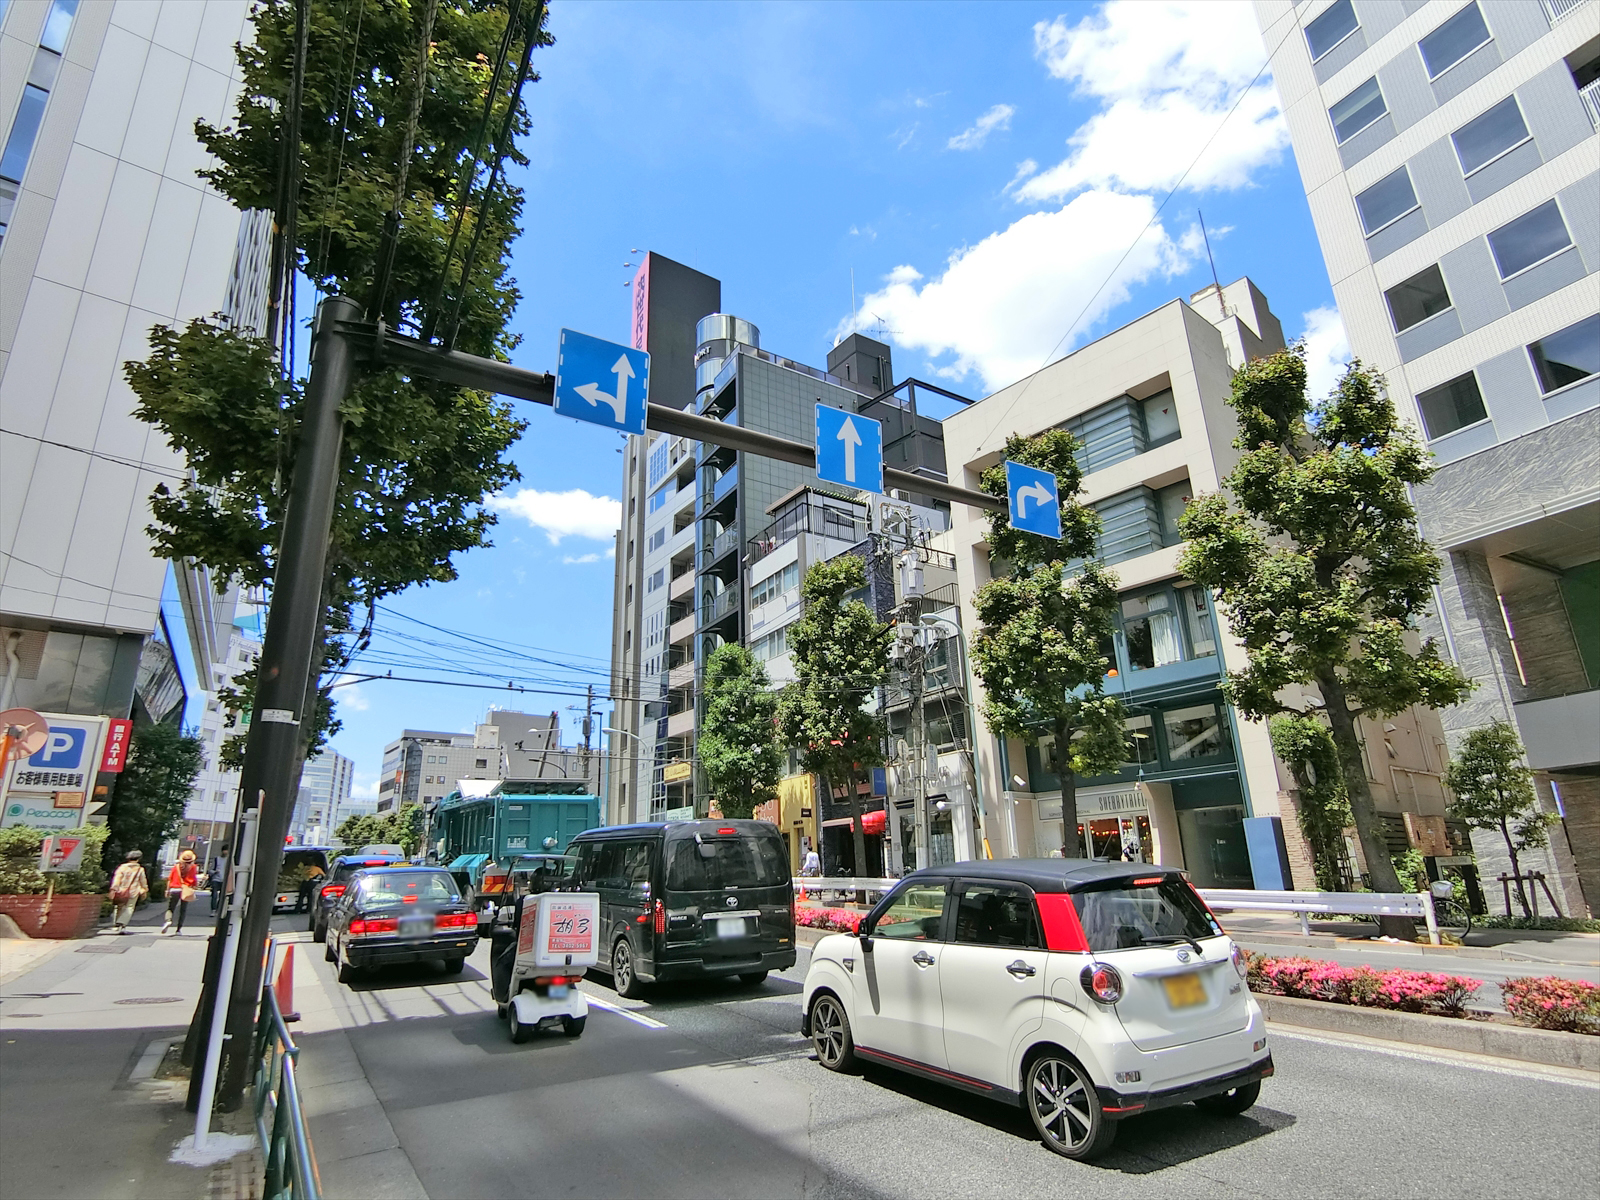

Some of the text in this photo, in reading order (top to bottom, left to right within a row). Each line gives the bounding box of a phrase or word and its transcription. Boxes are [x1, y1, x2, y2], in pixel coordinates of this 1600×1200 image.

[42, 732, 74, 762] P
[16, 771, 84, 787] お客様専用駐車場
[1098, 792, 1147, 811] SHERRYTRIFL
[26, 807, 77, 819] Peacock
